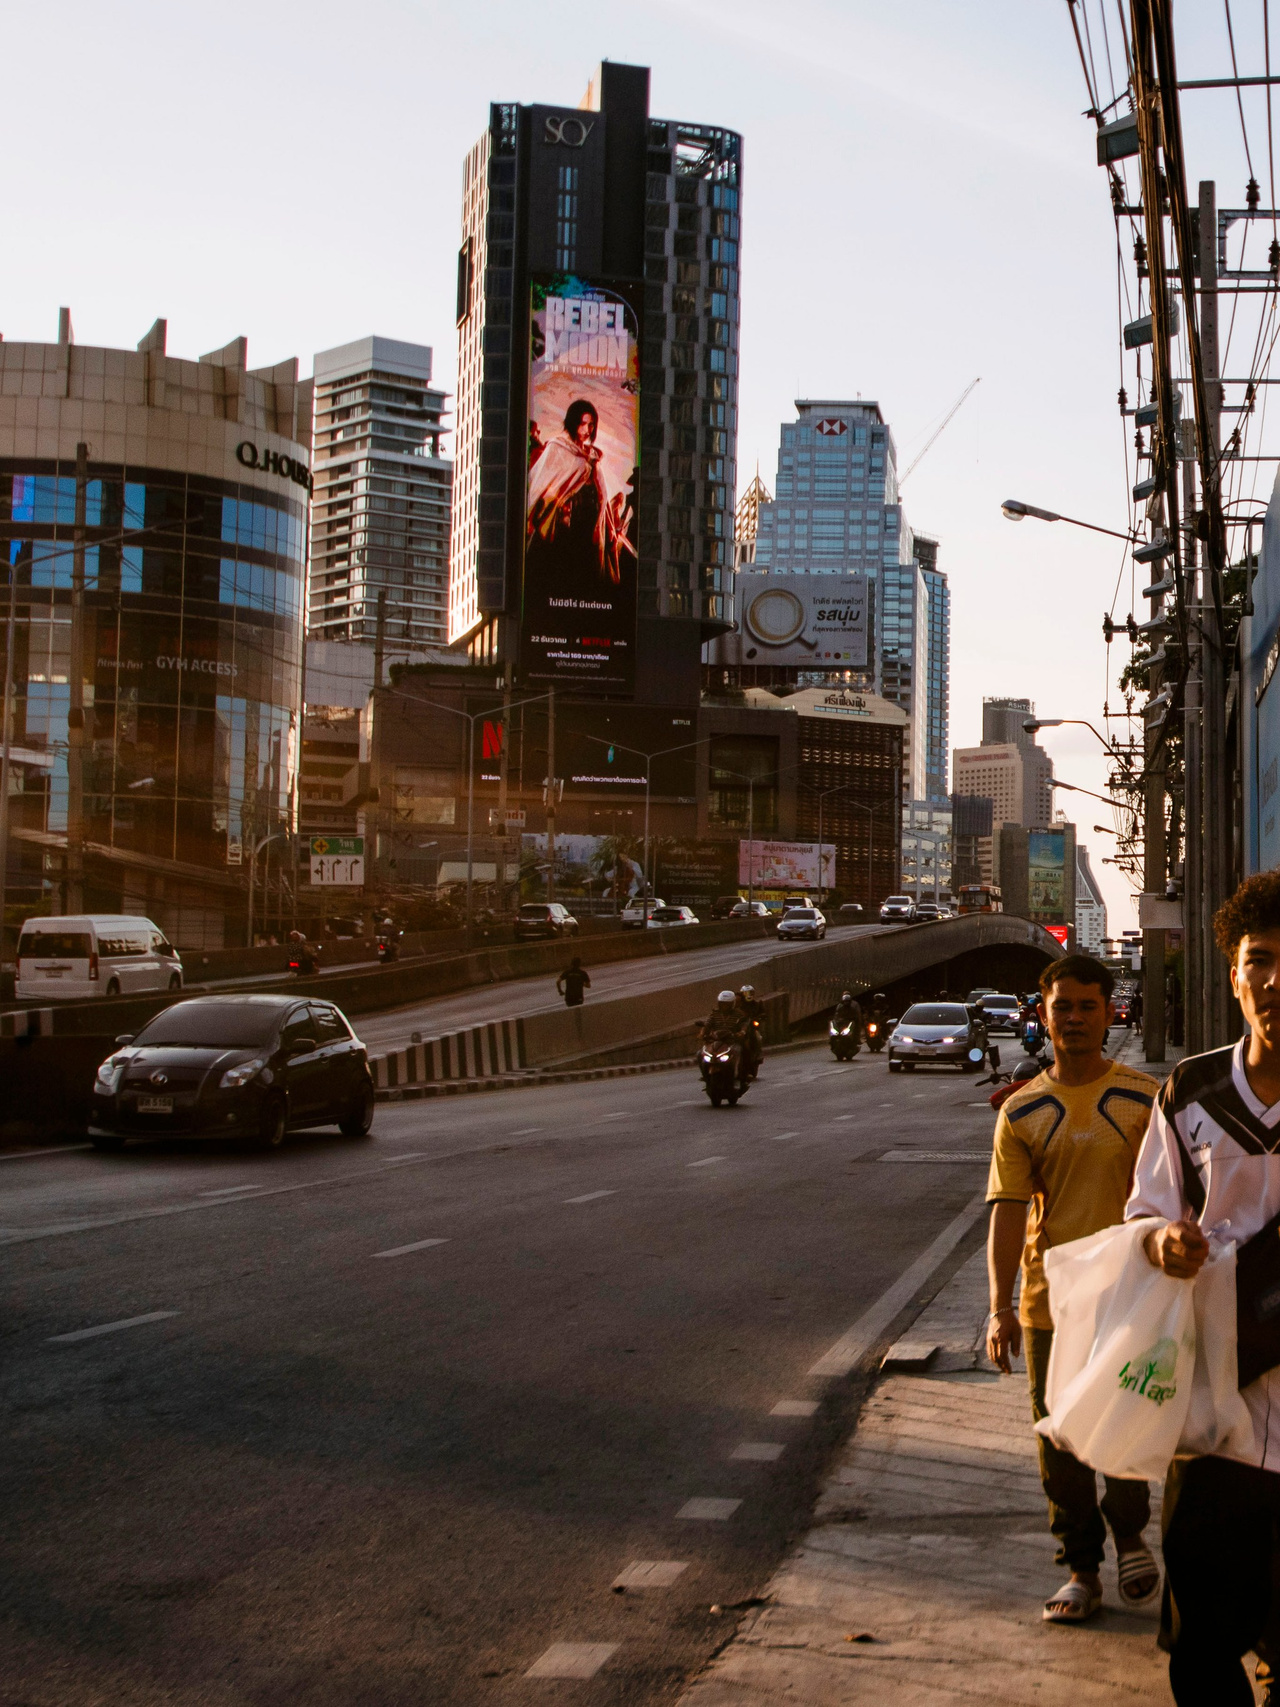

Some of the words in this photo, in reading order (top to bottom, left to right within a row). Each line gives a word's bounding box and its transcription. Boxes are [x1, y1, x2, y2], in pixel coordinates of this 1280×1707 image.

[546, 296, 628, 336] REBEL
[545, 330, 628, 370] MOON
[817, 606, 861, 627] รสนุ่ม
[531, 635, 540, 643] 22
[541, 635, 567, 644] ธันวาคม
[582, 636, 611, 647] NETFLIX
[156, 656, 188, 671] GYM
[190, 659, 239, 677] ACCESS
